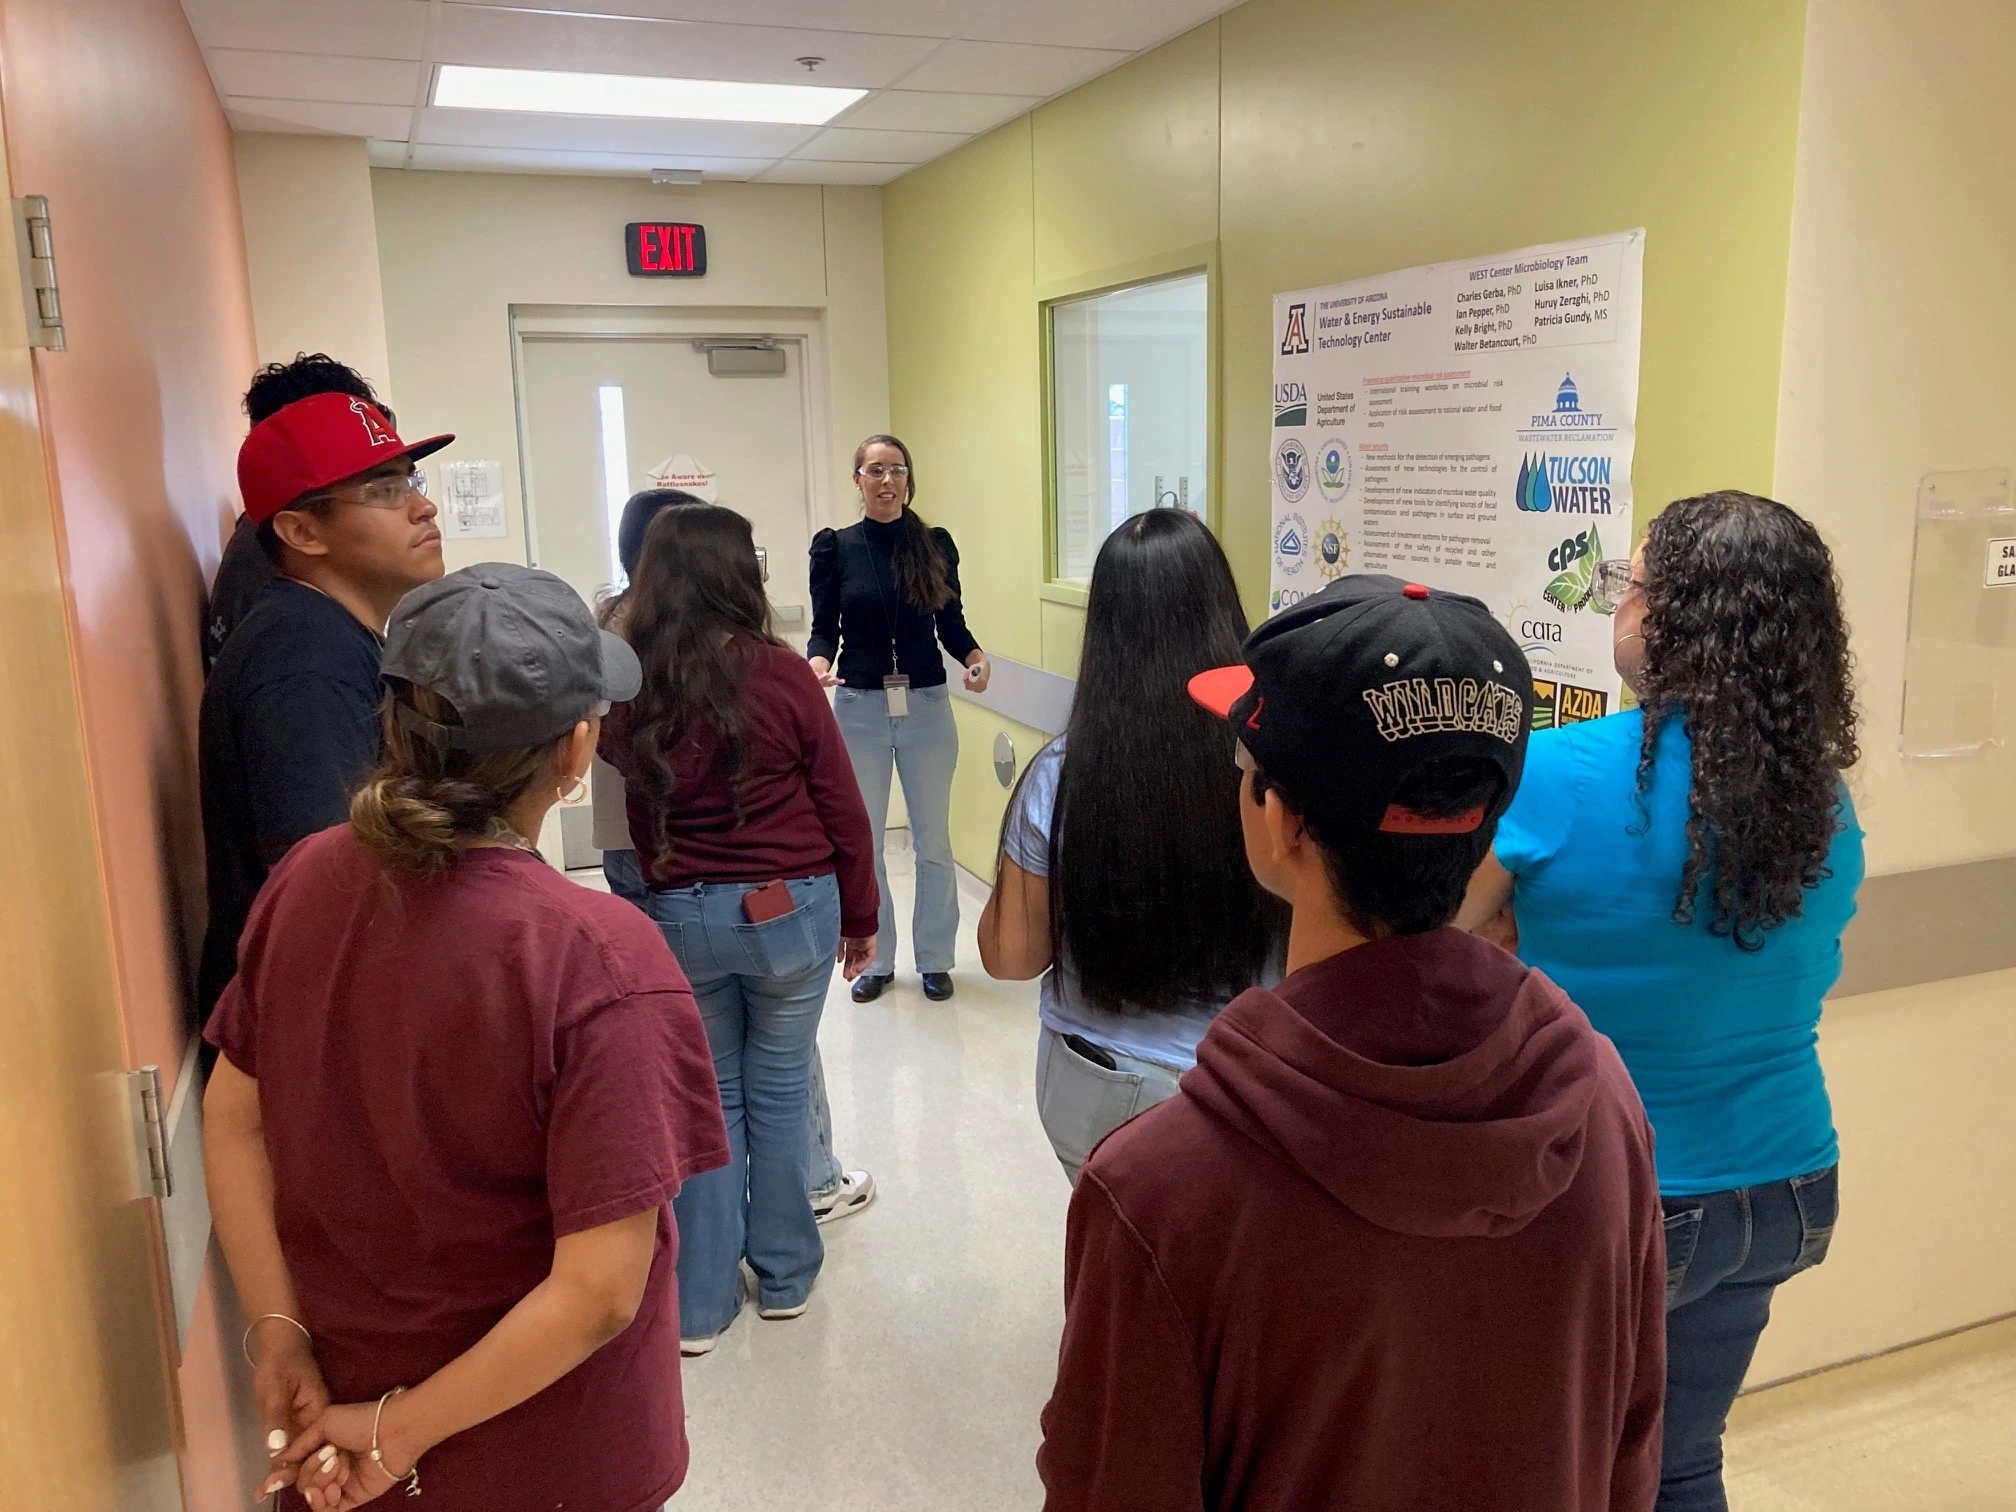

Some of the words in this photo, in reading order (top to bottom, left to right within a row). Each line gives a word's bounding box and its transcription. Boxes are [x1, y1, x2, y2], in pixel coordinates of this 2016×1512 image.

[640, 225, 696, 270] EXIT
[1470, 270, 1487, 281] WEST
[1490, 266, 1512, 277] Center
[1514, 259, 1564, 274] Microbiology
[1567, 255, 1588, 266] Team
[1535, 281, 1554, 292] Luisa
[1556, 278, 1578, 289] Ikner,
[1581, 274, 1597, 286] PhD
[1321, 302, 1329, 310] THE
[1330, 297, 1356, 309] UNIVERSITY
[1358, 296, 1364, 304] OF
[1365, 293, 1388, 302] ARIZONA
[1457, 291, 1481, 302] Charles
[1483, 289, 1505, 299] Gerba,
[1507, 285, 1522, 296] PhD
[1535, 298, 1557, 309] Huruy
[1560, 293, 1591, 307] Zerzghi,
[1594, 291, 1610, 302] PhD
[1320, 316, 1342, 329] Water
[1345, 313, 1350, 325] &
[1353, 311, 1380, 326] Energy
[1383, 302, 1431, 320] Sustainable
[1457, 309, 1467, 319] Ian
[1469, 307, 1494, 319] Pepper,
[1496, 304, 1509, 314] PhD
[1535, 315, 1562, 326] Patricia
[1565, 312, 1592, 323] Gundy,
[1594, 309, 1607, 319] MS
[1281, 303, 1309, 355] A
[1455, 324, 1472, 336] Kelly
[1474, 323, 1497, 335] Bright,
[1498, 320, 1512, 330] PhD
[1319, 334, 1362, 349] Technology
[1364, 332, 1391, 343] Center
[1454, 342, 1478, 351] Walter
[1480, 337, 1521, 349] Betancourt,
[1523, 335, 1536, 344] PhD
[1275, 382, 1307, 402] USDA
[1370, 386, 1396, 394] International
[1425, 383, 1448, 391] workshops
[1464, 380, 1488, 388] microbial
[1317, 393, 1335, 401] United
[1336, 392, 1353, 400] States
[1317, 405, 1348, 415] Department
[1350, 404, 1355, 412] of
[349, 397, 396, 446] A
[1317, 418, 1345, 428] Agriculture
[1531, 415, 1557, 427] PIMA
[1560, 414, 1602, 426] COUNTY
[1519, 433, 1562, 442] WASTEWATER
[1564, 433, 1614, 441] RECLAMATION
[1445, 454, 1464, 462] emerging
[1466, 454, 1490, 462] pathogens
[1549, 457, 1611, 484] TUCSON
[1443, 488, 1463, 496] microbial
[1552, 486, 1611, 514] WATER
[1364, 498, 1394, 506] Development
[1435, 500, 1458, 508] identifying
[1484, 501, 1497, 509] fecal
[1478, 514, 1496, 522] ground
[1274, 513, 1292, 553] NATIONAL
[1293, 512, 1308, 557] INSTITUTES
[1364, 530, 1390, 538] Assessment
[1391, 530, 1396, 538] of
[1422, 533, 1440, 541] systems
[1449, 536, 1470, 544] pathogen
[1323, 543, 1339, 555] NSF
[1364, 540, 1390, 548] Assessment
[1417, 544, 1431, 552] safety
[1445, 546, 1463, 554] recycled
[1283, 558, 1304, 576] HEALTH
[1364, 562, 1387, 570] agriculture
[1445, 558, 1462, 566] potable
[1486, 561, 1496, 569] and
[1543, 590, 1565, 613] CENTER
[1544, 668, 1576, 678] AGRICULTURE
[1554, 662, 1584, 672] DEPARTMENT
[1362, 678, 1523, 744] WILDCATS
[1561, 687, 1602, 719] AZDA
